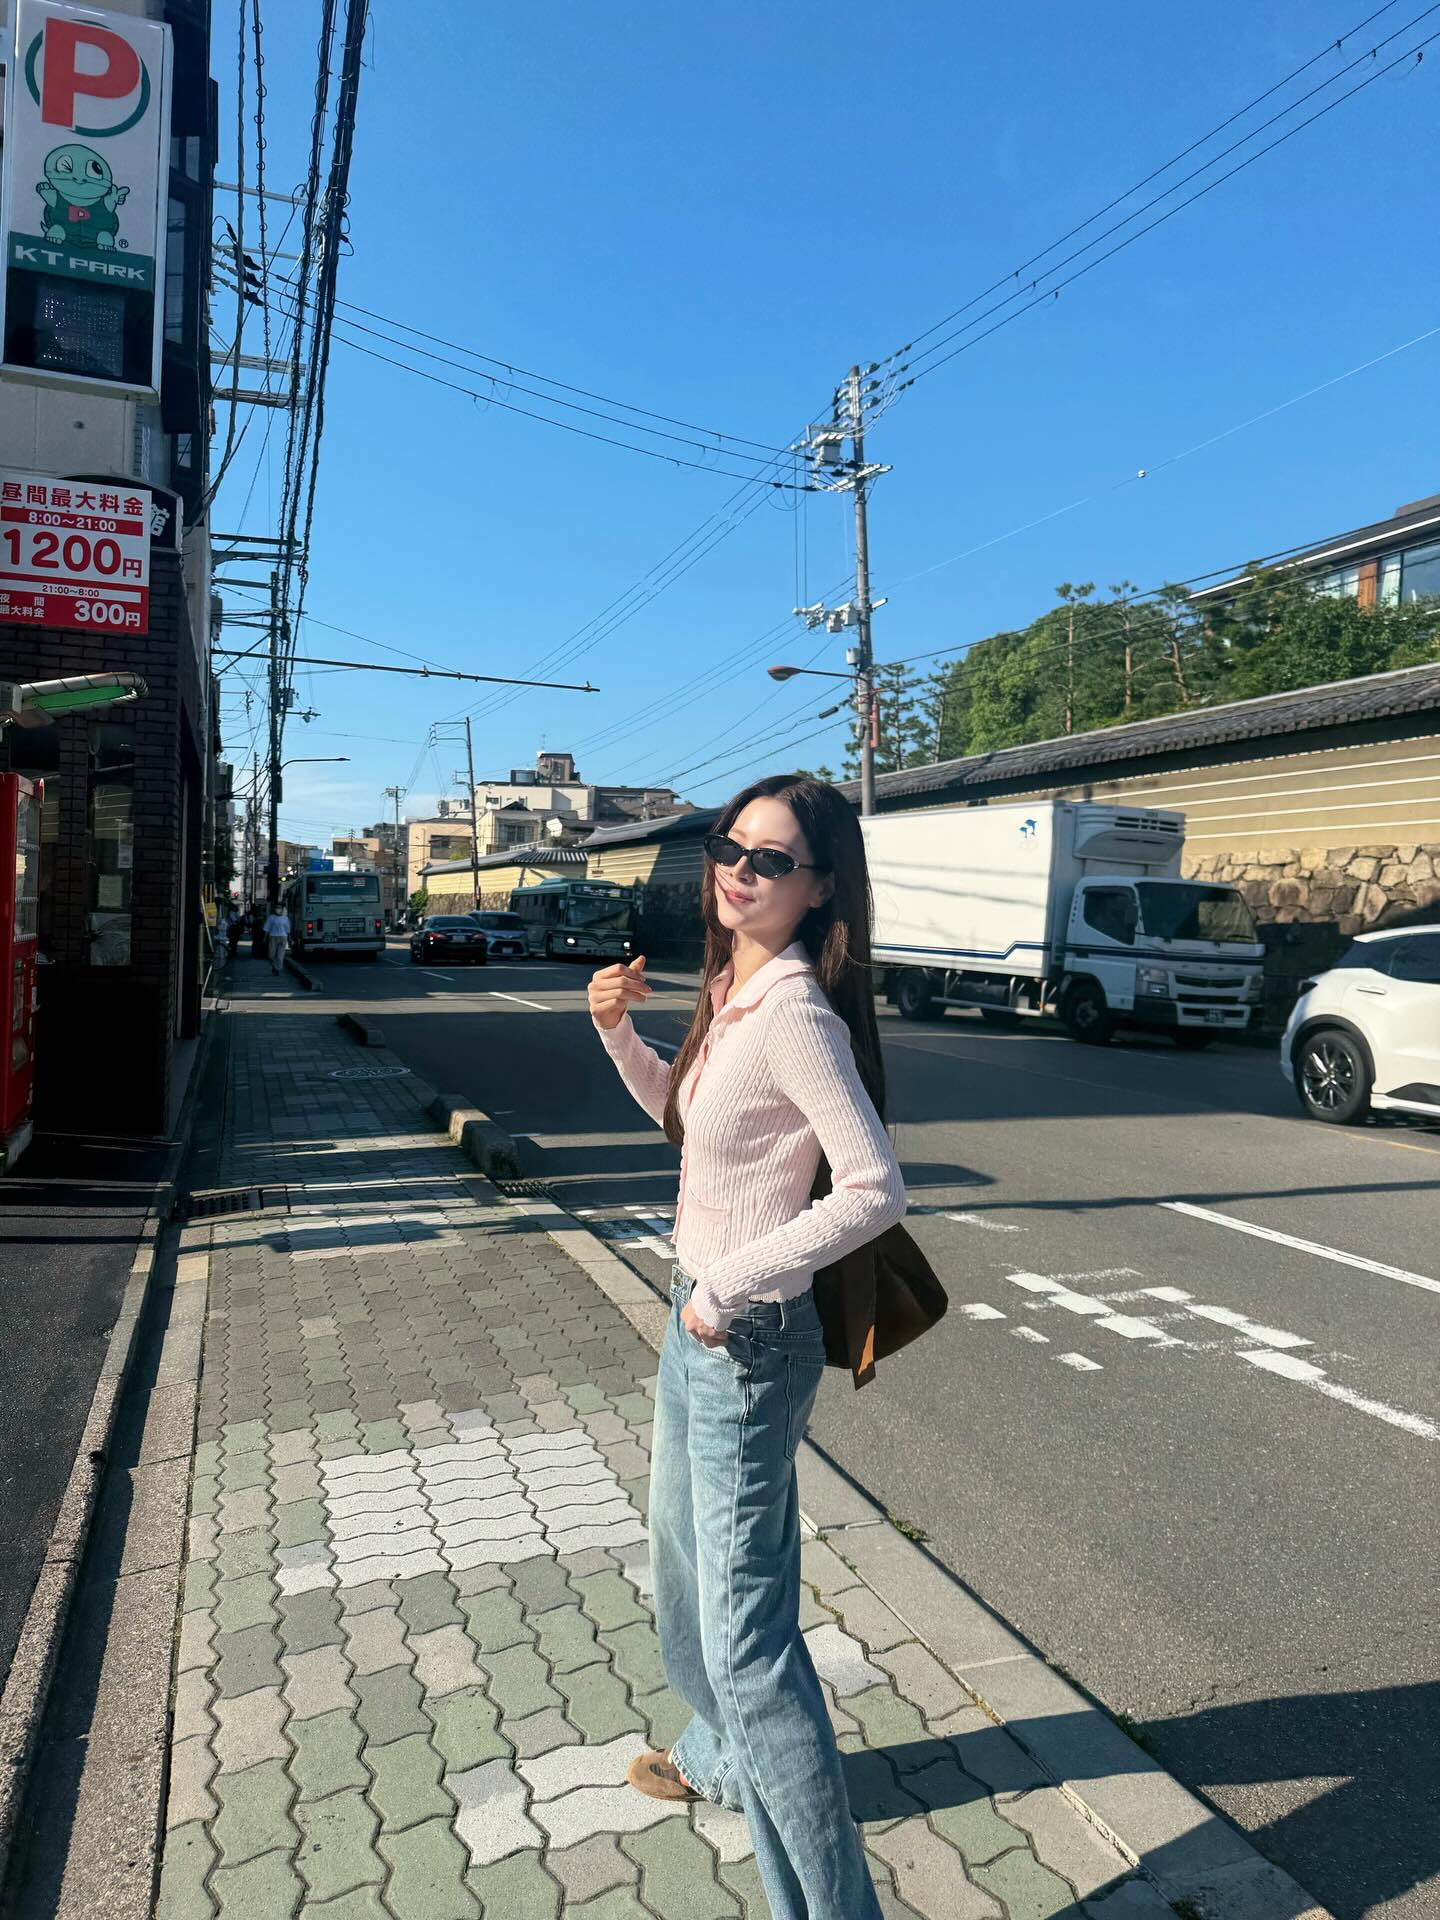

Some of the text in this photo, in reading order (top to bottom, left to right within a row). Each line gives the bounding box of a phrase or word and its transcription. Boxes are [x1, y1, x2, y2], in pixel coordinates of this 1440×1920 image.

[41, 17, 141, 129] P
[15, 245, 145, 280] KT PARK
[2, 482, 144, 517] 昼間最大料金
[3, 528, 143, 578] 1200円
[74, 600, 141, 627] 300円
